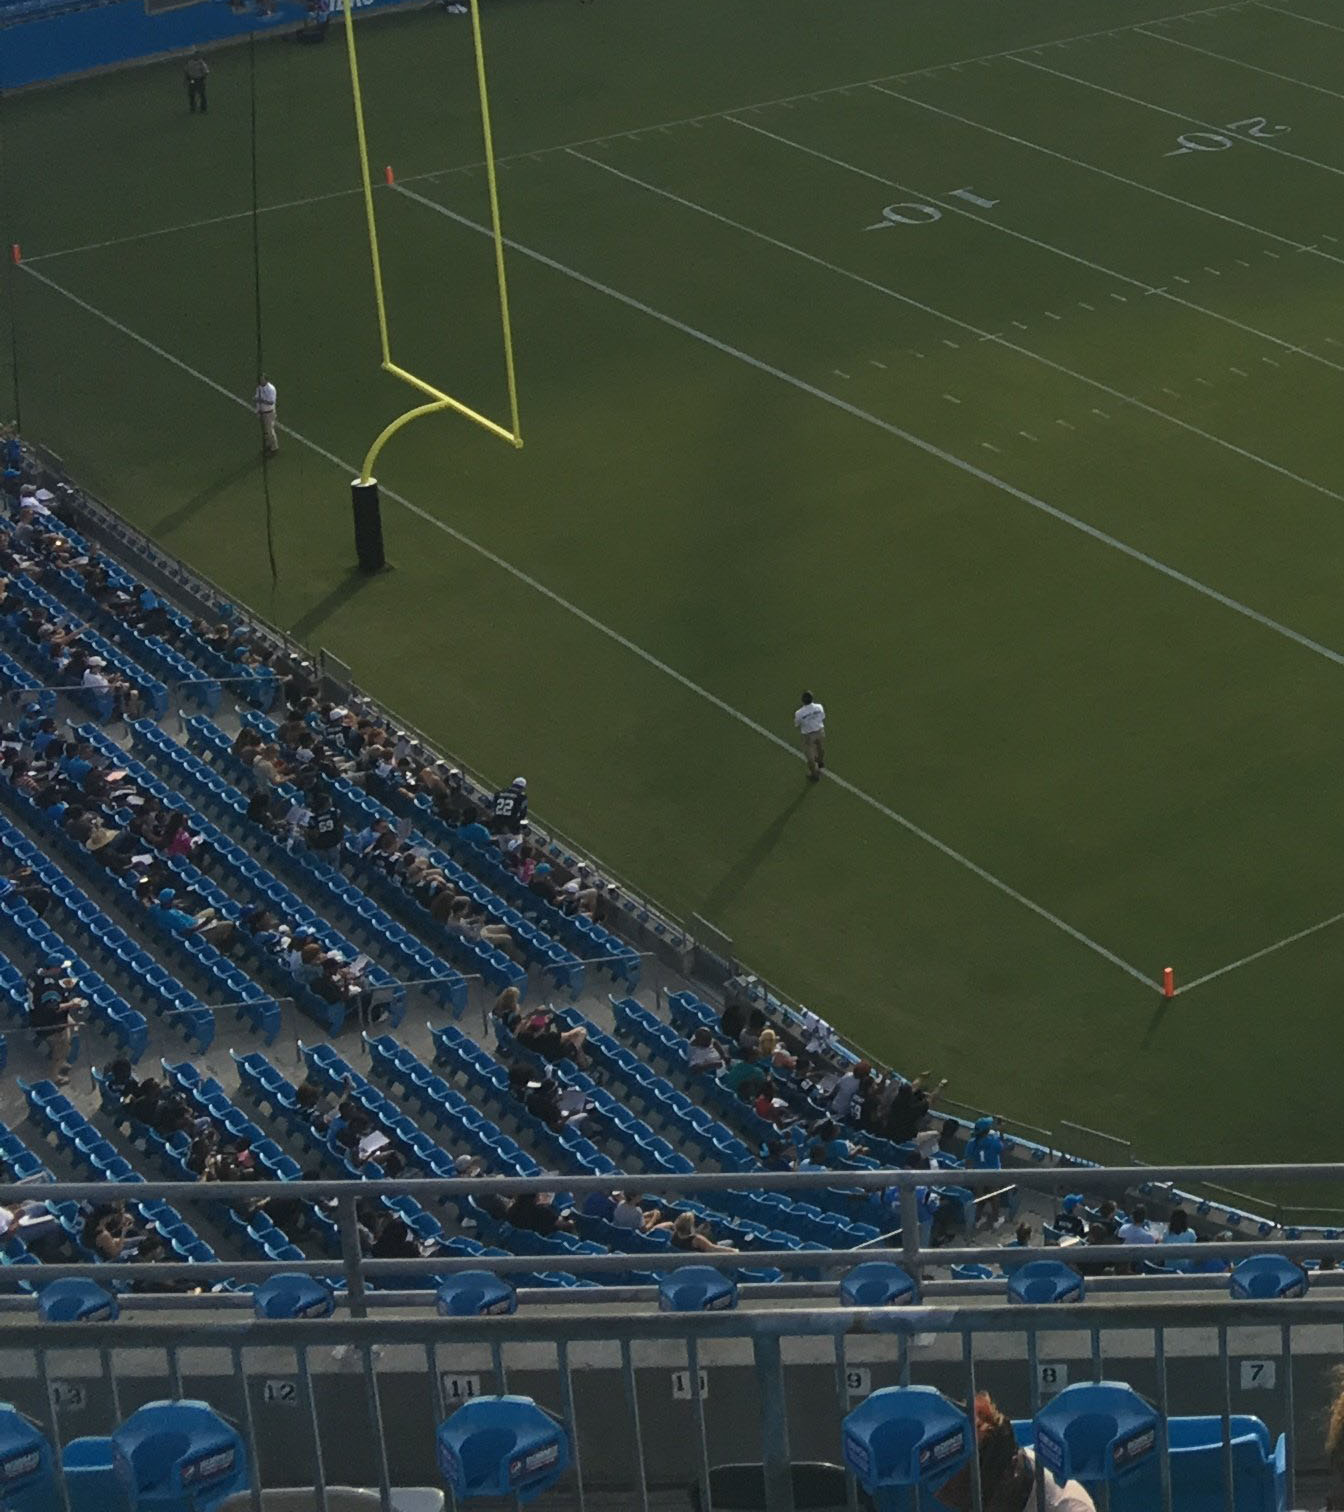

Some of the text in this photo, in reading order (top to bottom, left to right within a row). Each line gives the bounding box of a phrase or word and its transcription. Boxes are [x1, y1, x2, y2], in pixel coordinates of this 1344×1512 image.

[1176, 114, 1292, 153] 20
[881, 186, 1001, 228] 10
[847, 1372, 862, 1389] 9
[1042, 1368, 1056, 1383] 8
[1250, 1364, 1264, 1382] 7
[266, 1382, 295, 1401] 12
[451, 1379, 474, 1398] 11
